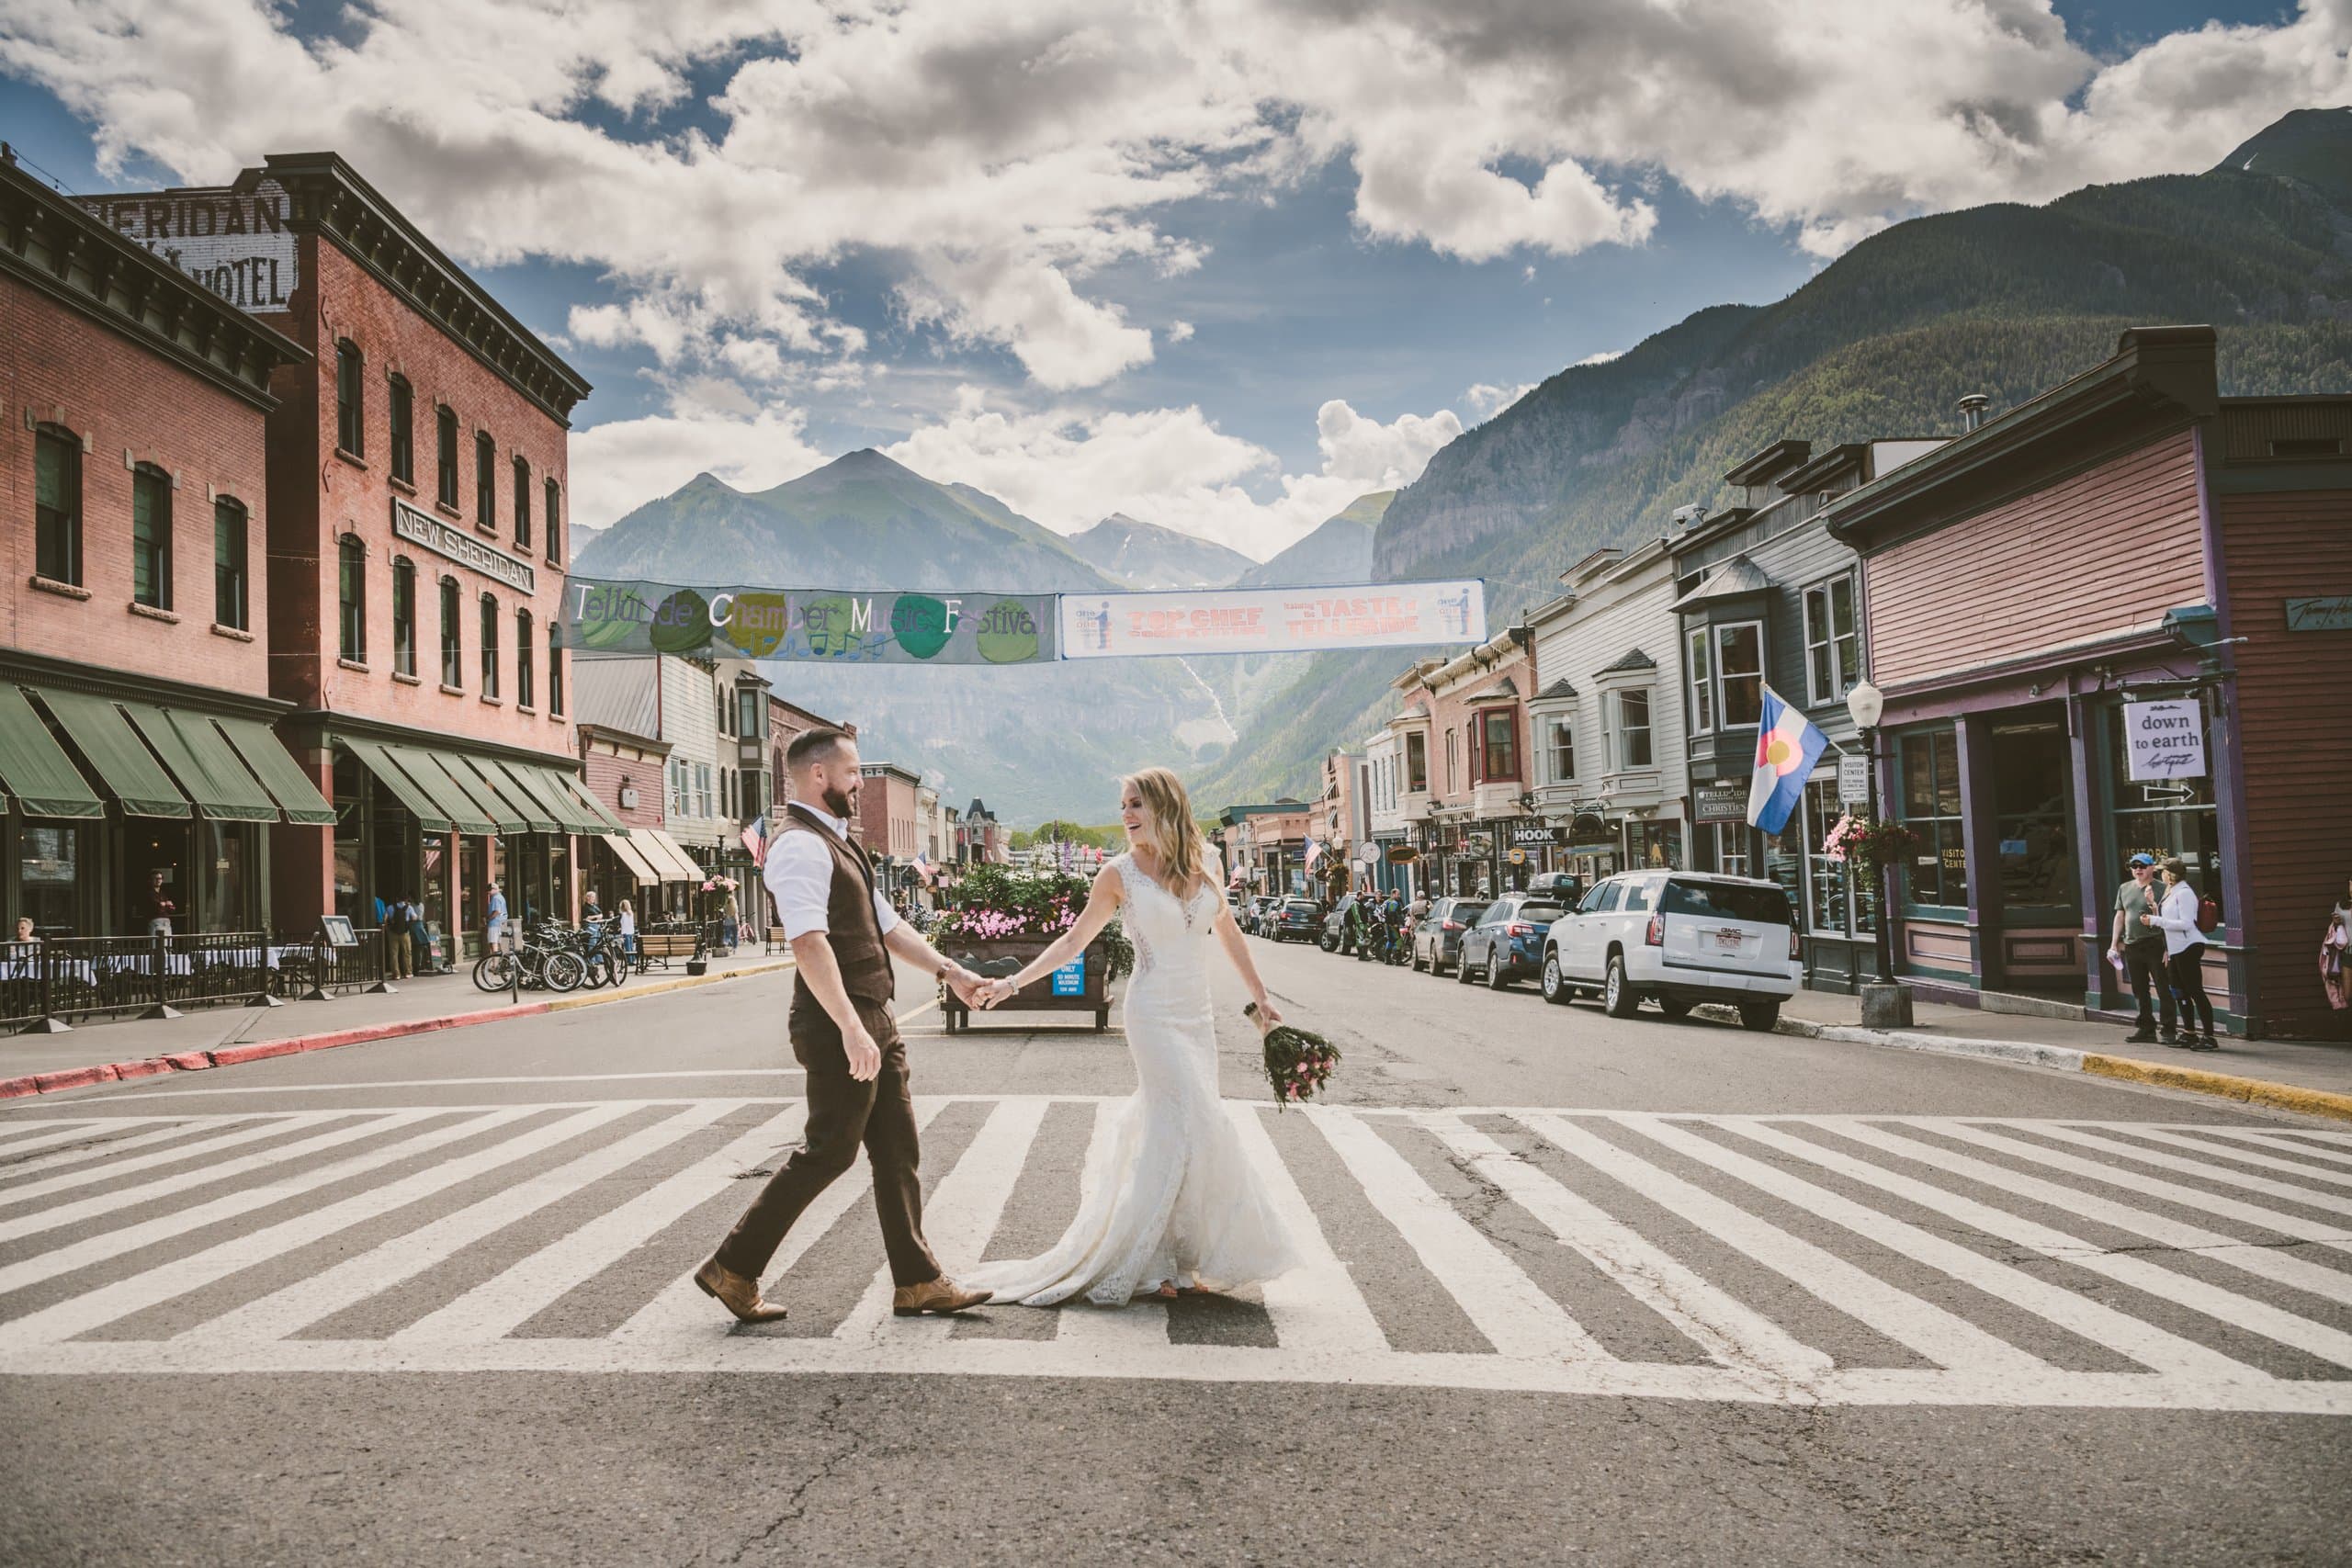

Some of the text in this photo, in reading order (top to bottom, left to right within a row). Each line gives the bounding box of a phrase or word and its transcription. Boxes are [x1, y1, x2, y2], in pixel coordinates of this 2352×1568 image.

[397, 506, 530, 590] NEW SHERIDAN
[574, 583, 1045, 635] Telluride Chamber Music Festival
[1315, 596, 1402, 618] TASTE
[1126, 607, 1263, 631] TOP CHEF
[2142, 716, 2190, 730] down
[2135, 731, 2199, 750] to earth
[1704, 790, 1747, 798] TELLUIDE
[1514, 829, 1555, 841] HOOK
[1941, 848, 1966, 858] VISITO
[1944, 860, 1967, 869] CENTE
[1721, 927, 1742, 935] GMC
